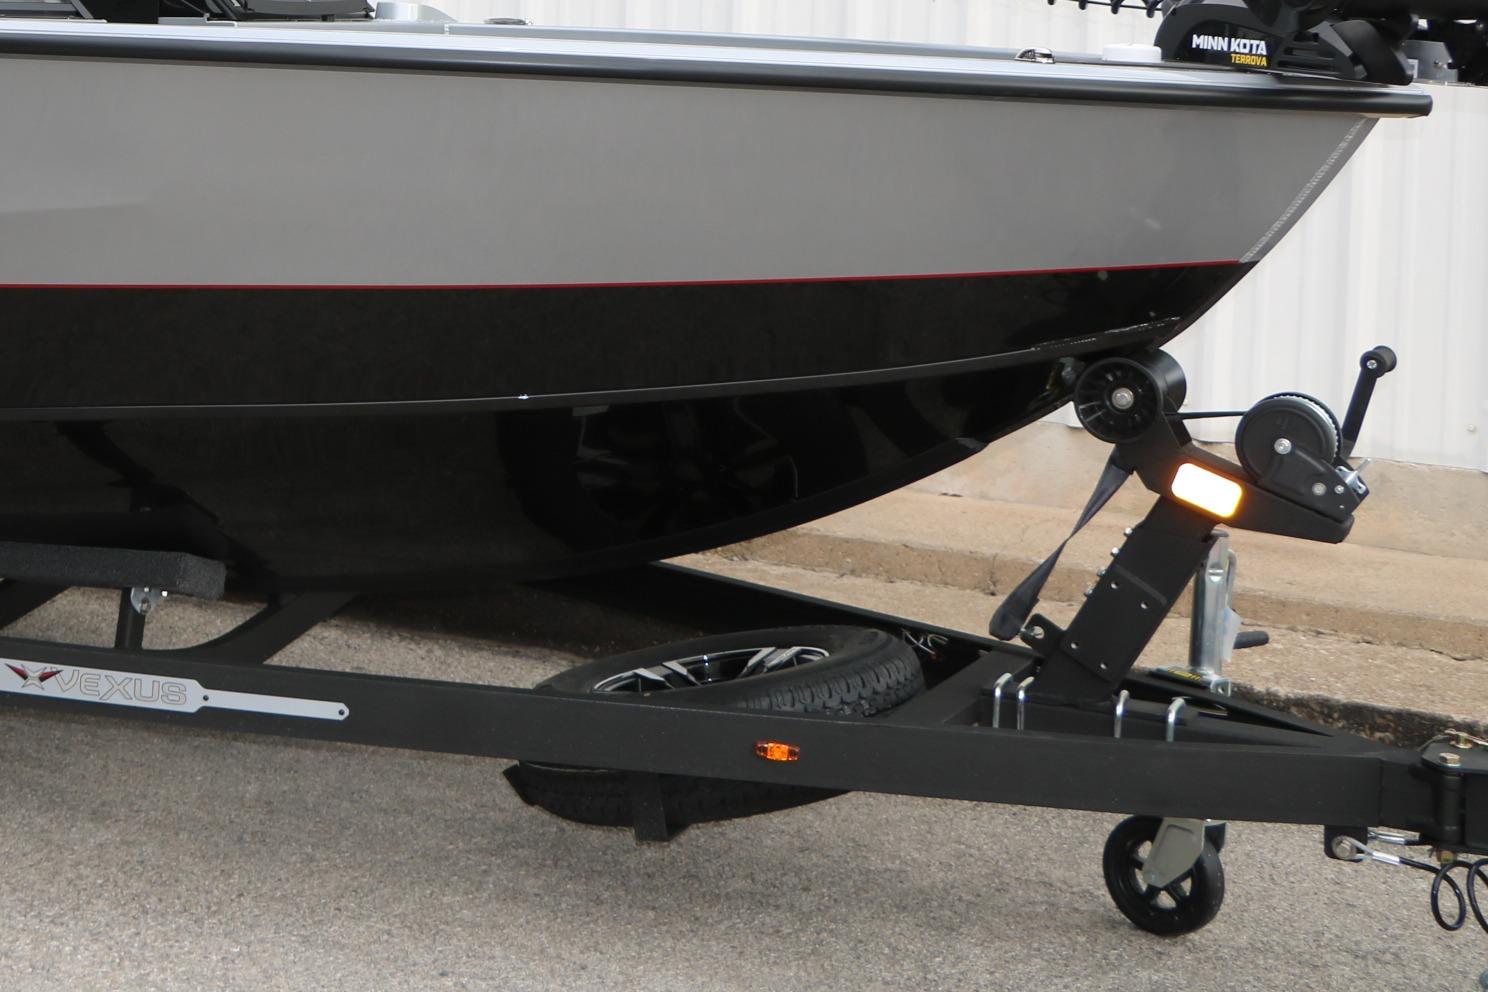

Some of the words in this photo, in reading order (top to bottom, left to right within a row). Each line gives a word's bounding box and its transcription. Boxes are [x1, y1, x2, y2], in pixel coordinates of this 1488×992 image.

[1192, 34, 1228, 51] MINN
[1230, 38, 1267, 55] KOTA
[1231, 53, 1267, 66] TERROVA
[50, 666, 188, 705] VEXUS
